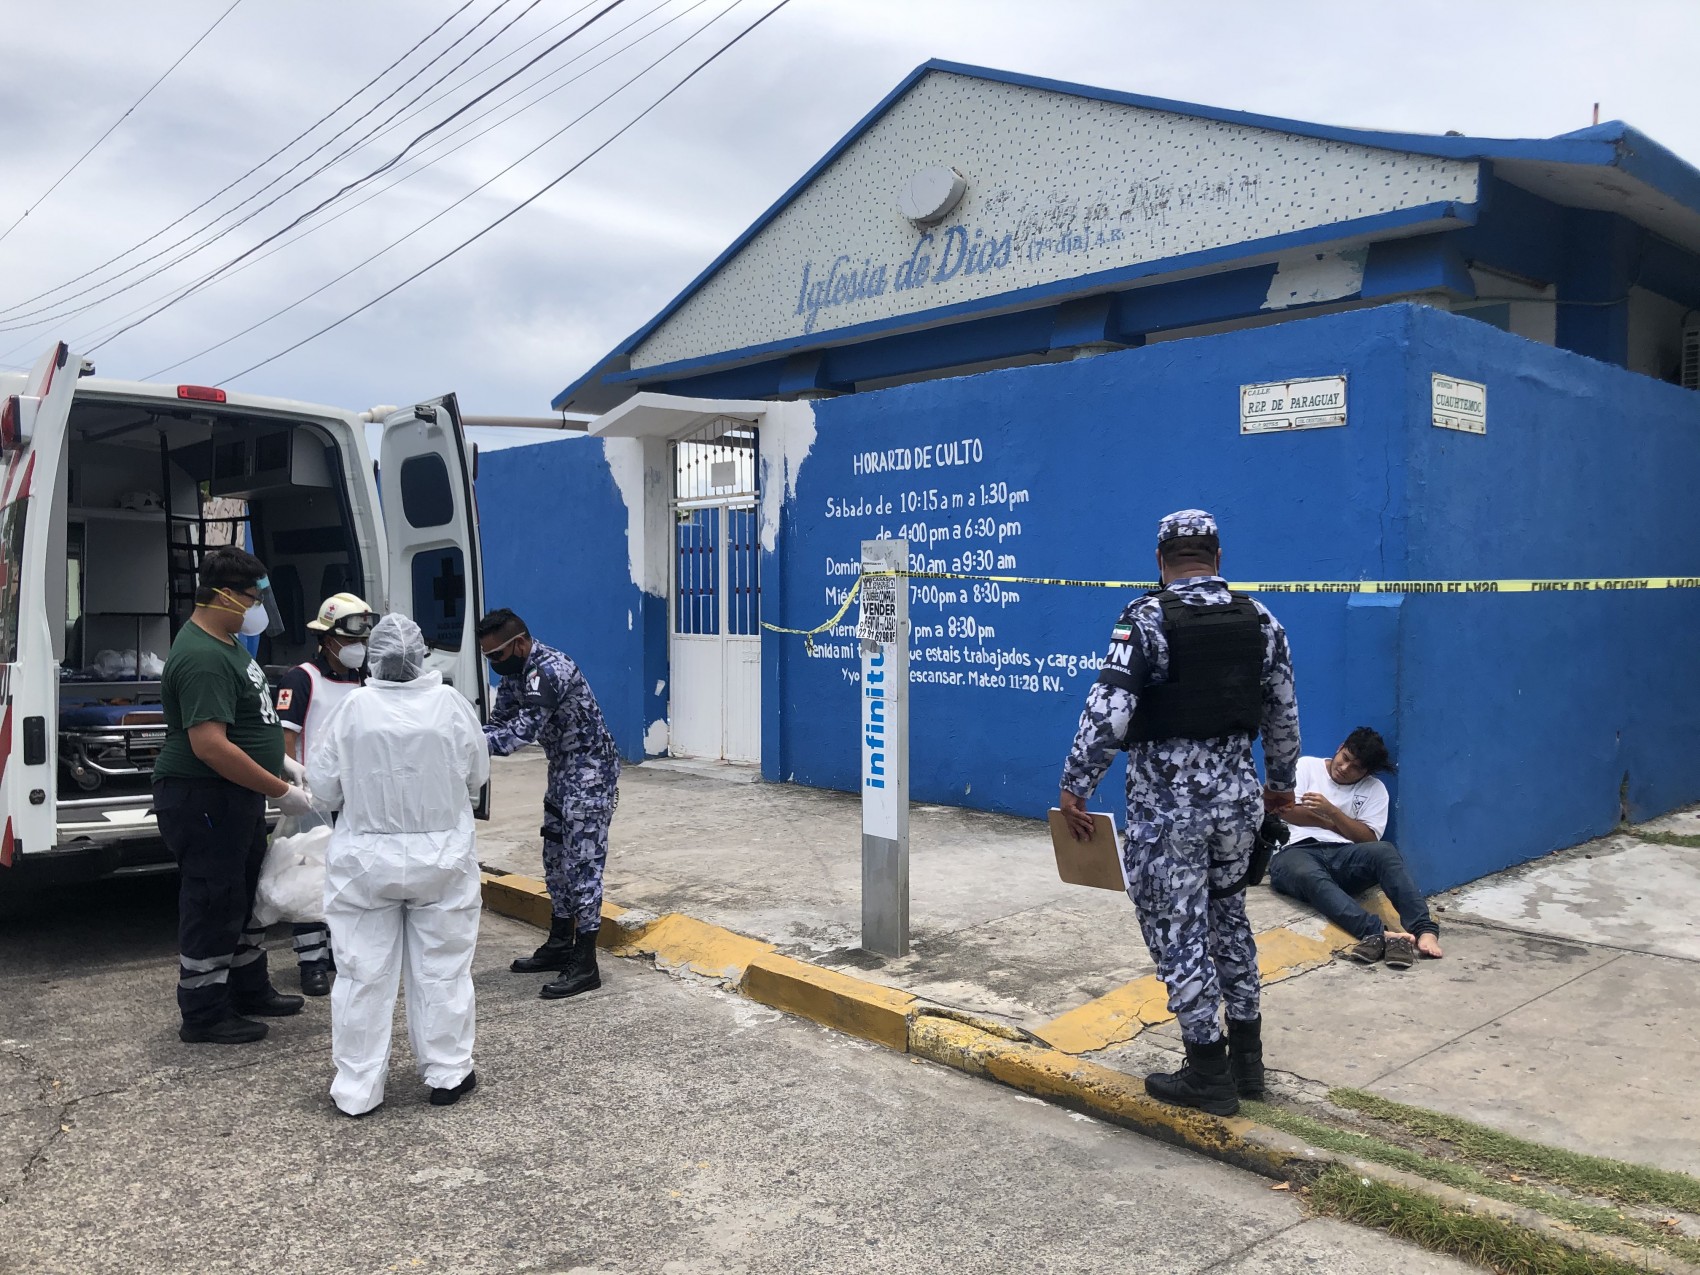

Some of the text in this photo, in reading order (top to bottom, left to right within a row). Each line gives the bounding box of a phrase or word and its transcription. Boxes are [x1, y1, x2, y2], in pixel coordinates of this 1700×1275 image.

[795, 254, 888, 334] Iglesia
[893, 233, 935, 293] de
[931, 225, 1014, 283] Dios
[1247, 388, 1271, 397] CALLE
[1248, 393, 1340, 415] REP. DE PARAGUAY
[1436, 394, 1482, 413] CUAUHTEMOC
[854, 438, 983, 475] HORARIO DE CULTO
[875, 495, 893, 514] de
[901, 489, 938, 513] 10:15
[968, 492, 976, 507] a
[980, 482, 1008, 506] 1:30
[1009, 490, 1030, 512] pm
[876, 517, 1022, 551] de 4:00 pm a 6:30 pm
[826, 557, 861, 576] Domin
[927, 558, 947, 573] am
[952, 557, 960, 572] a
[962, 549, 994, 572] 9:30
[997, 554, 1017, 570] am
[863, 602, 896, 616] VENDER
[960, 589, 968, 604] a
[973, 582, 1001, 604] 8:30
[1001, 590, 1020, 609] pm
[826, 619, 859, 638] Viern
[914, 625, 933, 646] pm
[935, 624, 944, 638] a
[948, 616, 977, 639] 8:30
[978, 625, 995, 646] pm
[925, 646, 961, 664] estais
[963, 646, 1031, 672] trabajados
[1034, 657, 1045, 673] y
[1047, 651, 1106, 677] cargado
[1111, 664, 1132, 676] NAVAL
[909, 669, 966, 687] escansar.
[968, 671, 1006, 688] Mateo
[1008, 674, 1039, 692] 11:28
[1043, 675, 1064, 692] RV.
[866, 645, 885, 789] infinitu
